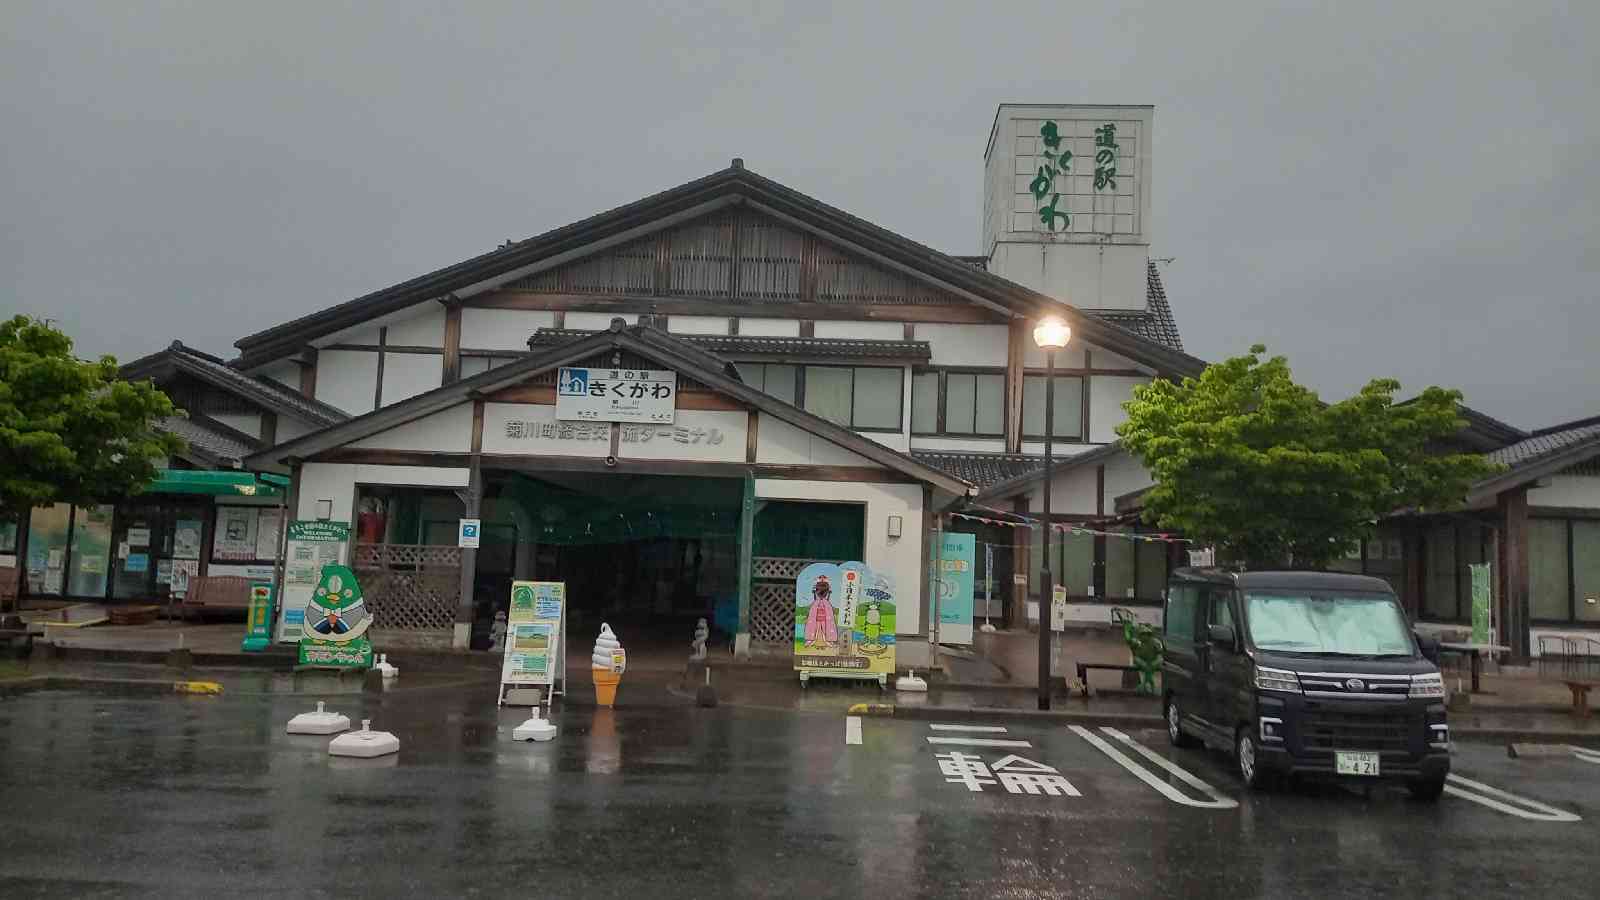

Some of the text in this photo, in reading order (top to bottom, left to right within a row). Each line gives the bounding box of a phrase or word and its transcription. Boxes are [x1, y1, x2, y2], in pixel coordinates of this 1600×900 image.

[1093, 123, 1119, 190] 道の駅
[609, 370, 650, 380] 道の駅
[588, 381, 671, 399] きくがわ
